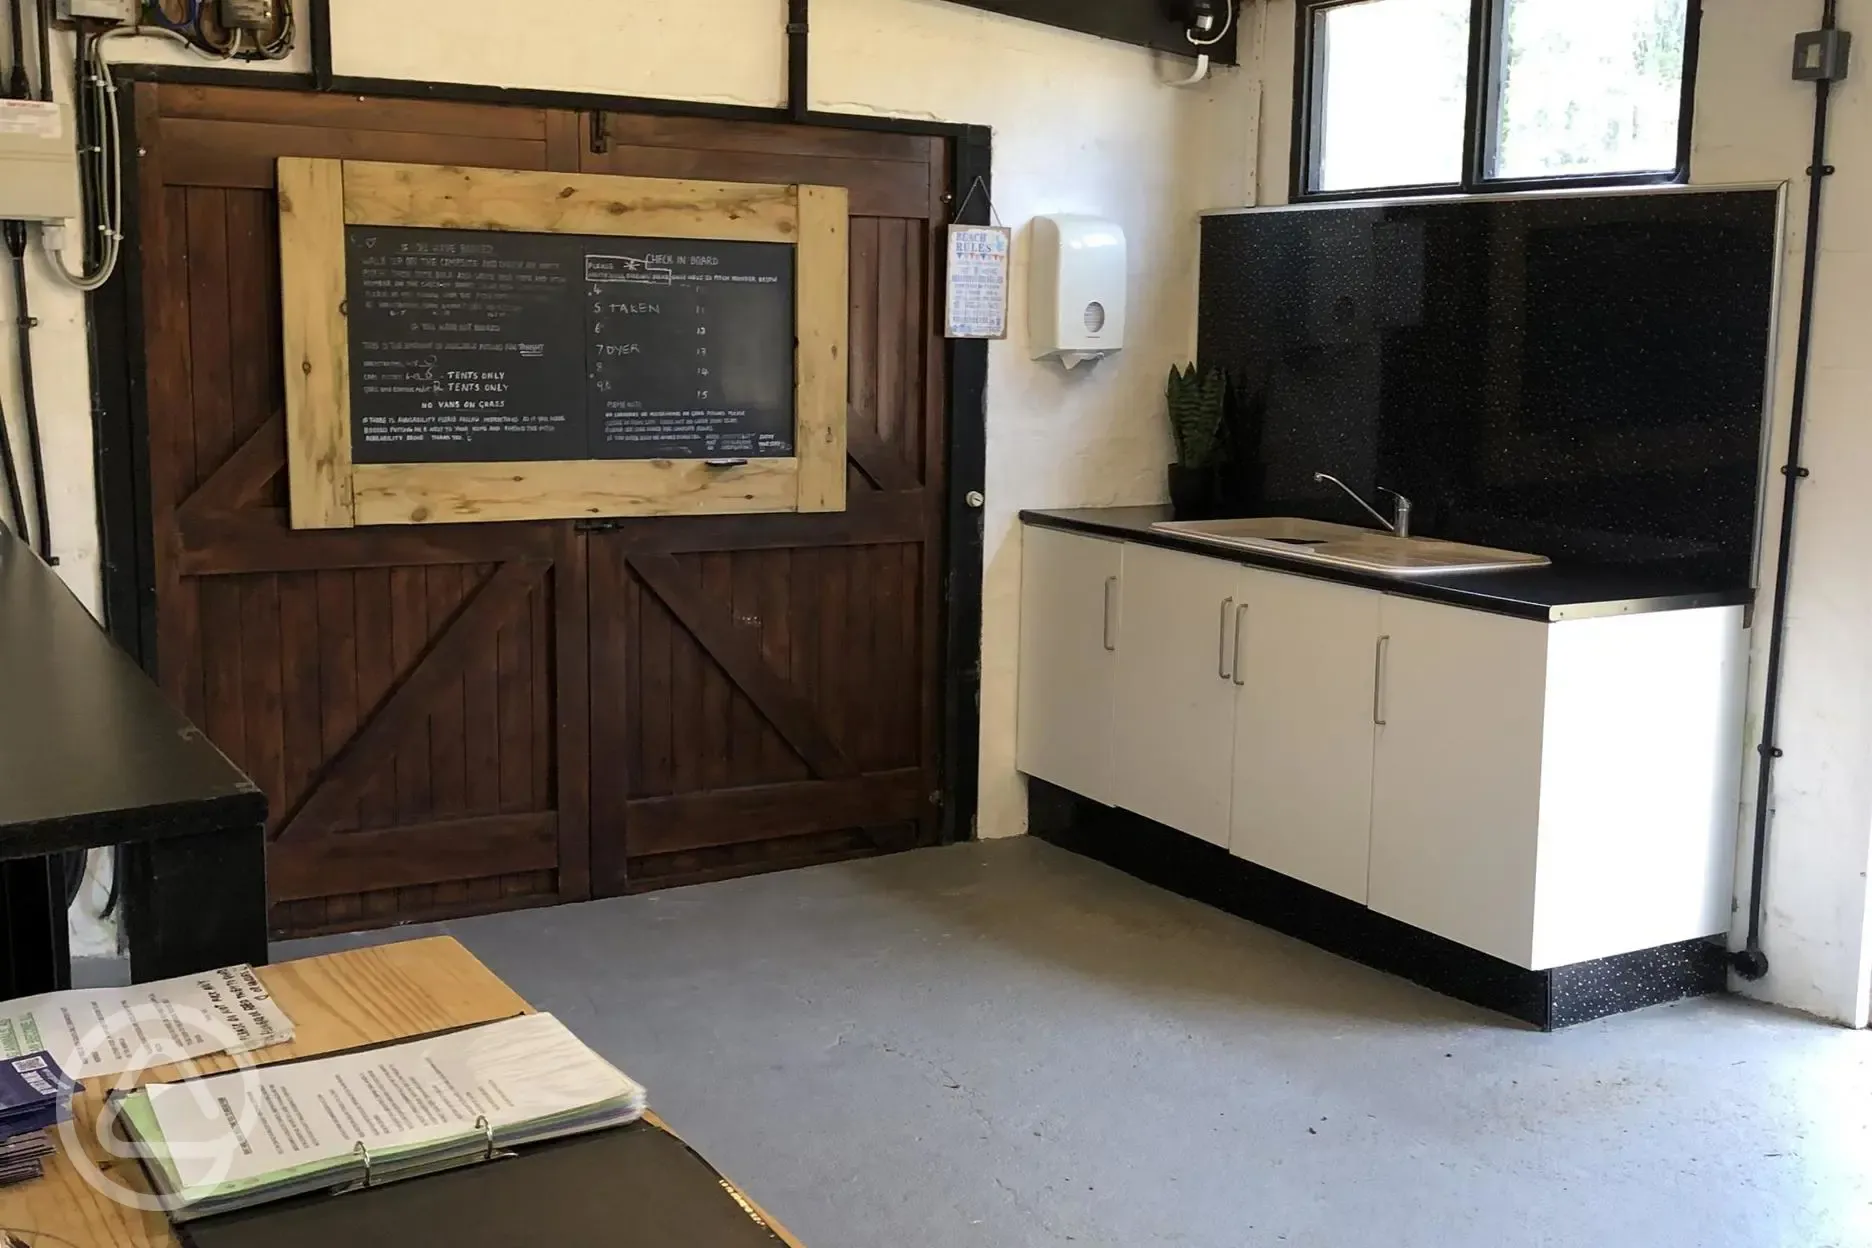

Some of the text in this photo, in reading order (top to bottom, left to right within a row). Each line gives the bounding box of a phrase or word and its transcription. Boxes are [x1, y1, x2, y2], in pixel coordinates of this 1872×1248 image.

[956, 232, 987, 242] BEACH
[955, 242, 992, 253] RULES
[645, 254, 719, 266] CHECK IN BOARD
[593, 284, 602, 295] 4
[608, 303, 660, 314] TAKEN
[518, 343, 545, 352] TONIGHT
[596, 344, 640, 356] 7 DYER
[448, 371, 478, 380] TENTS
[481, 371, 506, 380] ONLY
[448, 383, 480, 392] TENTS
[484, 383, 510, 392] ONLY
[697, 390, 709, 400] 15
[421, 400, 506, 410] NO VANS ON GRASS
